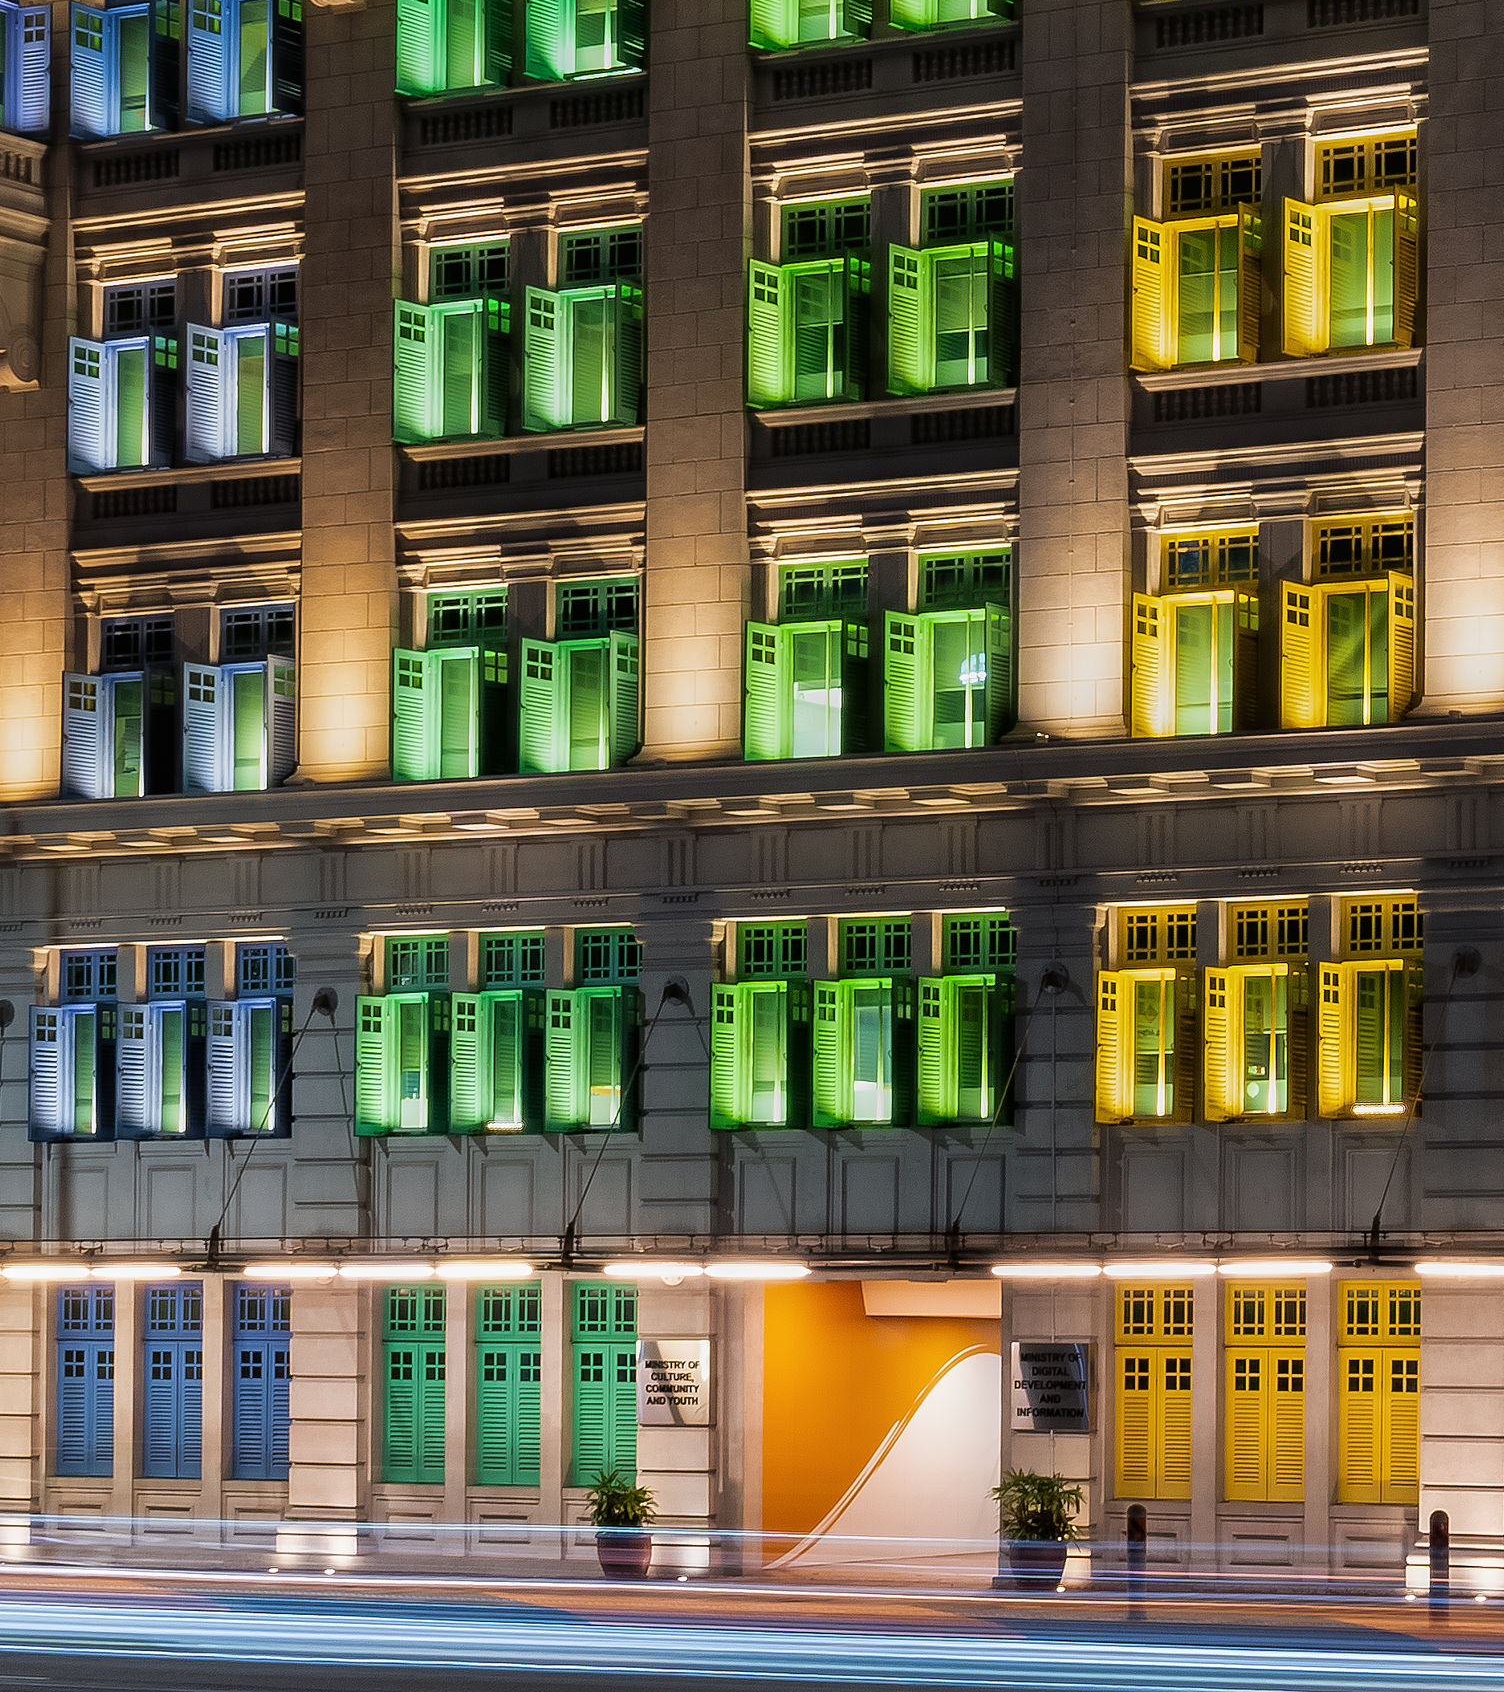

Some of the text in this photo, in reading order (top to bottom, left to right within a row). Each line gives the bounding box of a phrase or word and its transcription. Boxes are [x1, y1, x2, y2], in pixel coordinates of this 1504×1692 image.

[1021, 1353, 1081, 1363] MINISTRY OF
[645, 1361, 700, 1369] MINISTRY OF
[1032, 1367, 1070, 1376] DIGITAL
[651, 1372, 695, 1383] CULTURE,
[645, 1385, 700, 1393] COMMUNITY
[1014, 1380, 1086, 1390] DEVELOPMENT
[646, 1396, 699, 1405] AND YOUTH
[1040, 1394, 1061, 1404] AND
[1016, 1407, 1084, 1417] INFORMATION
